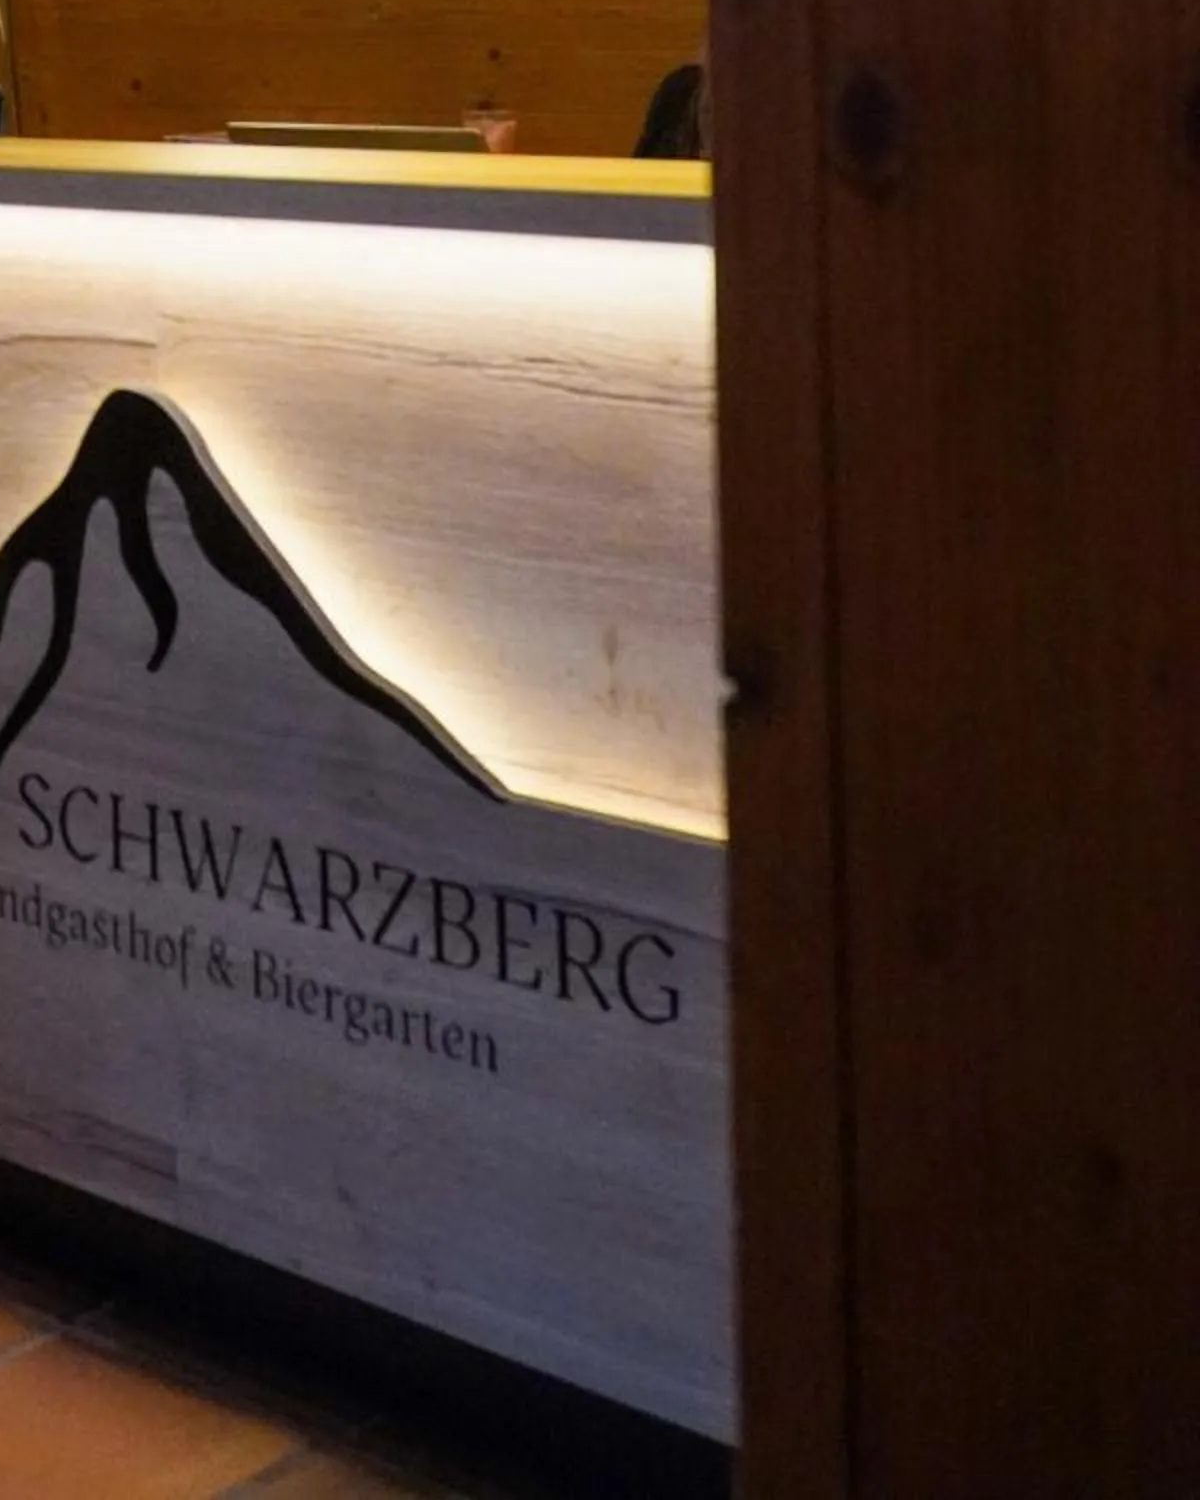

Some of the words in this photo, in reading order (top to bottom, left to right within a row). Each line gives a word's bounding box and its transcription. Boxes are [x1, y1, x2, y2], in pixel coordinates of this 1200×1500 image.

[17, 771, 680, 1025] SCHWARZBERG
[205, 935, 235, 989] &
[252, 949, 499, 1073] Biergarten
